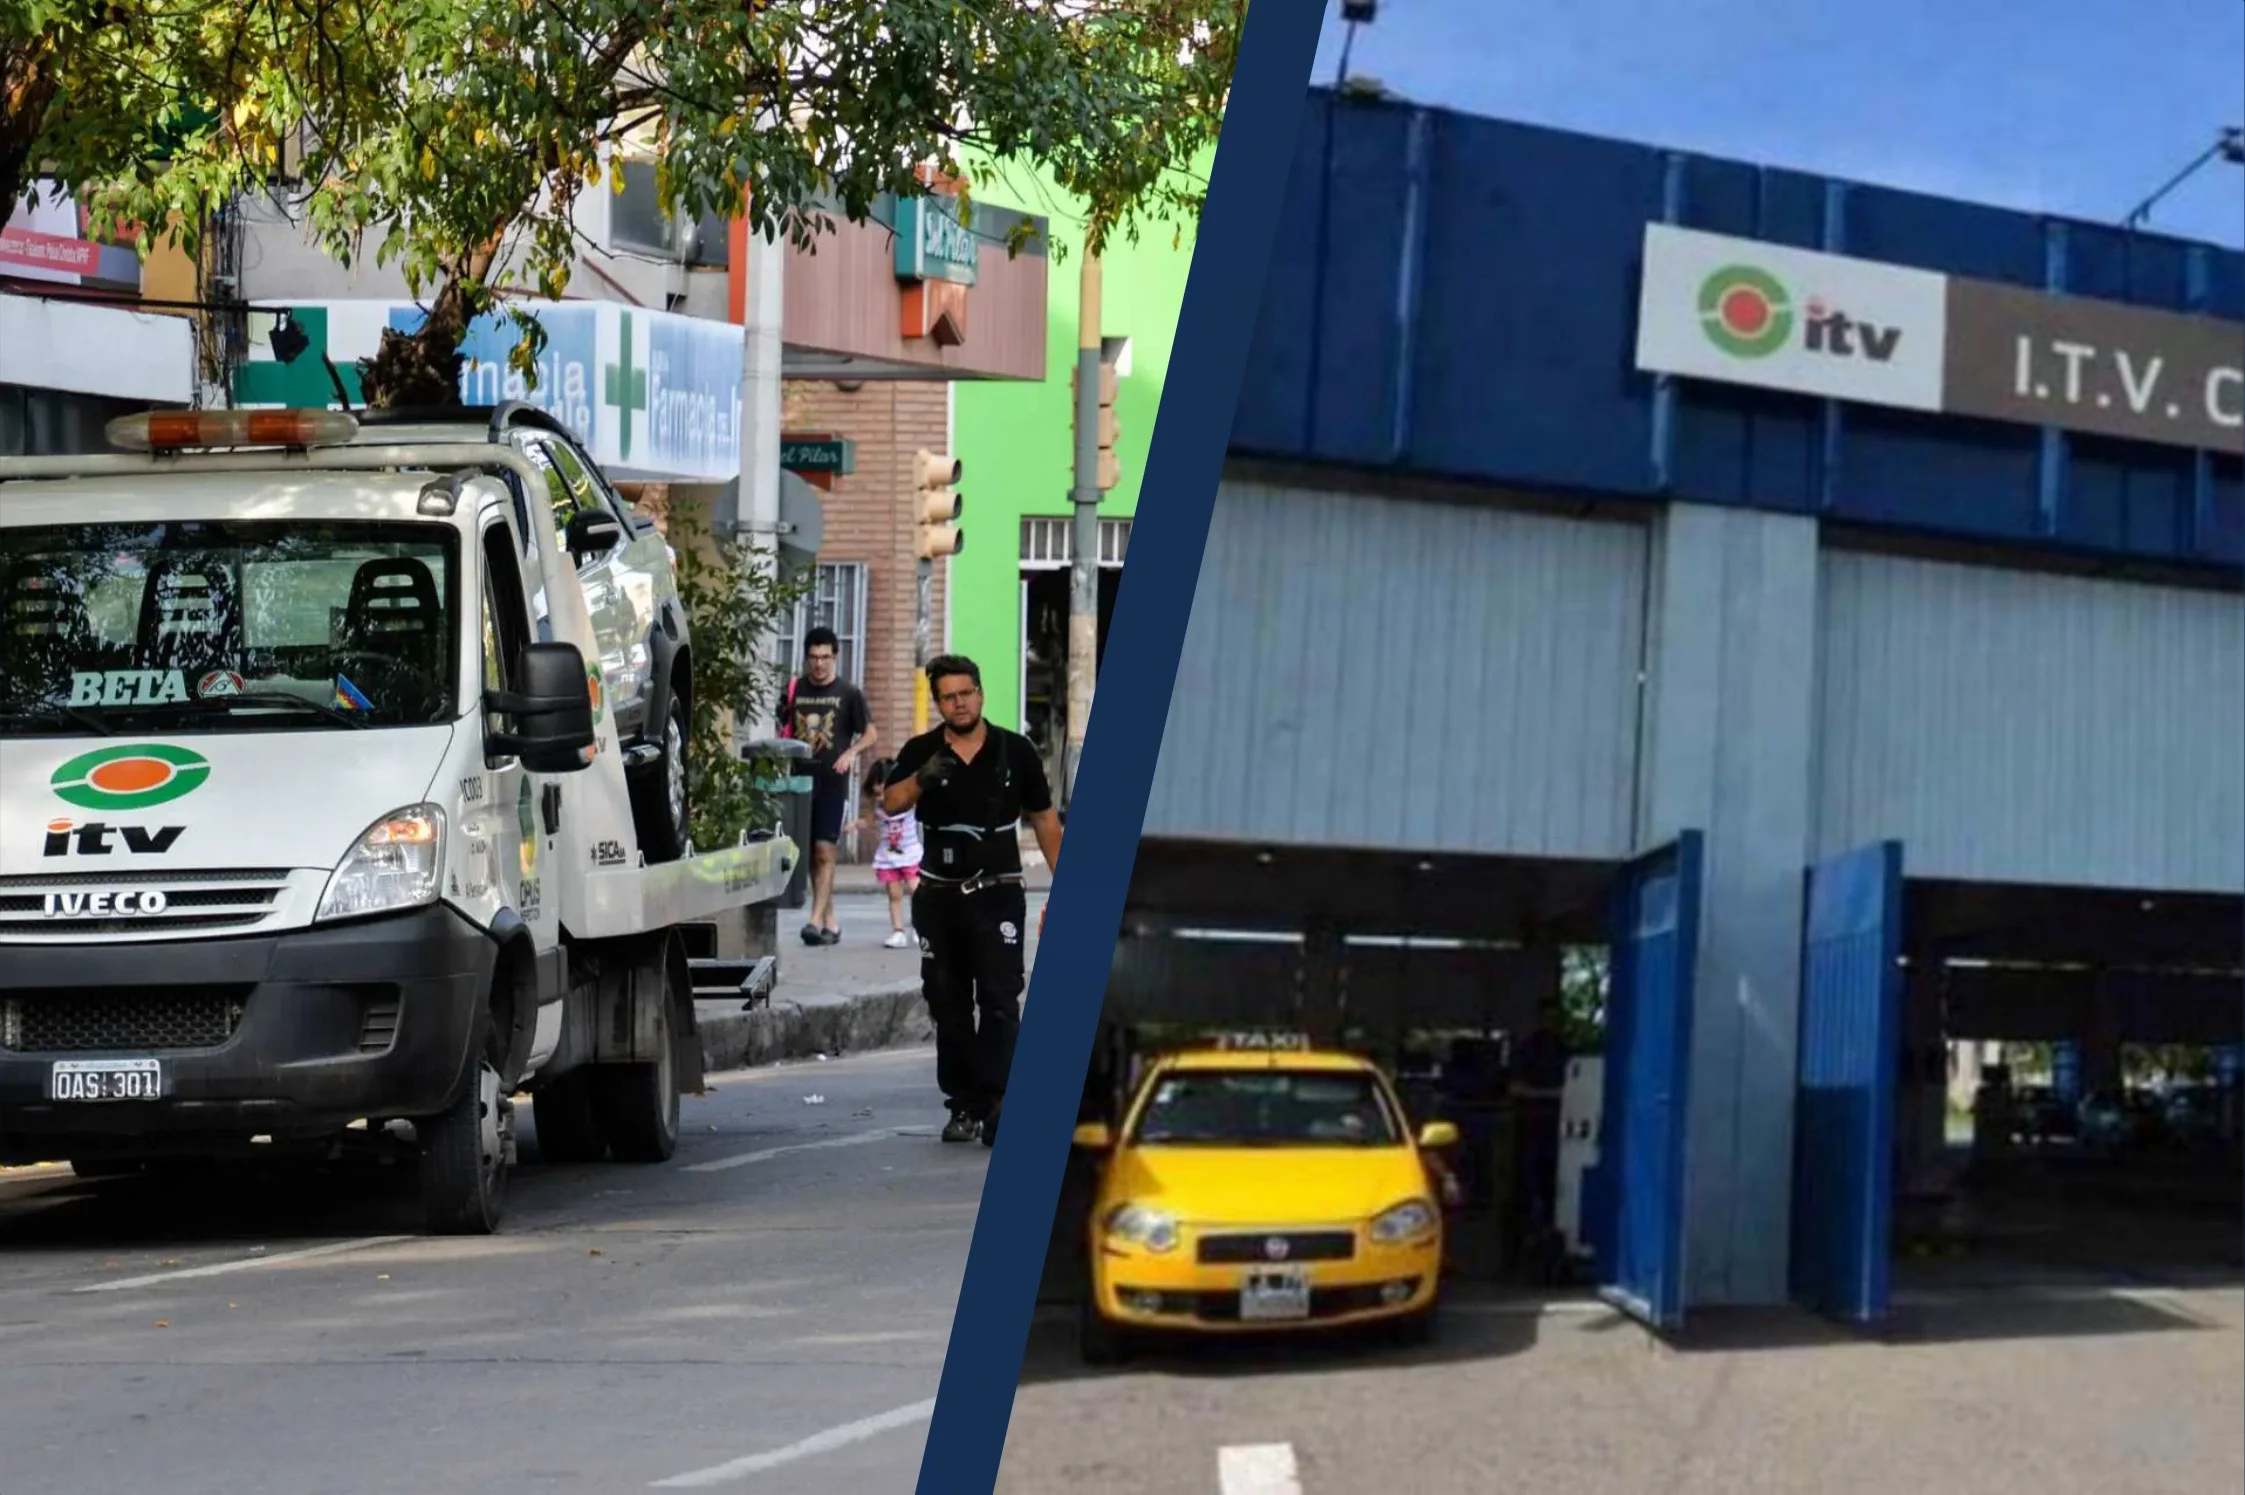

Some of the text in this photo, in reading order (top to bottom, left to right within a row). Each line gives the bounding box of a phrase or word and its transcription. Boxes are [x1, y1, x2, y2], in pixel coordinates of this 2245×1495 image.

[1804, 297, 1903, 362] itv
[2016, 335, 2180, 419] I.T.V.
[798, 445, 838, 463] Pilar
[67, 669, 190, 707] BETA
[43, 818, 187, 857] itv
[599, 842, 619, 860] SICA
[44, 890, 167, 918] IVECO
[1234, 1032, 1299, 1050] TAXI
[57, 1071, 157, 1100] OAS 301
